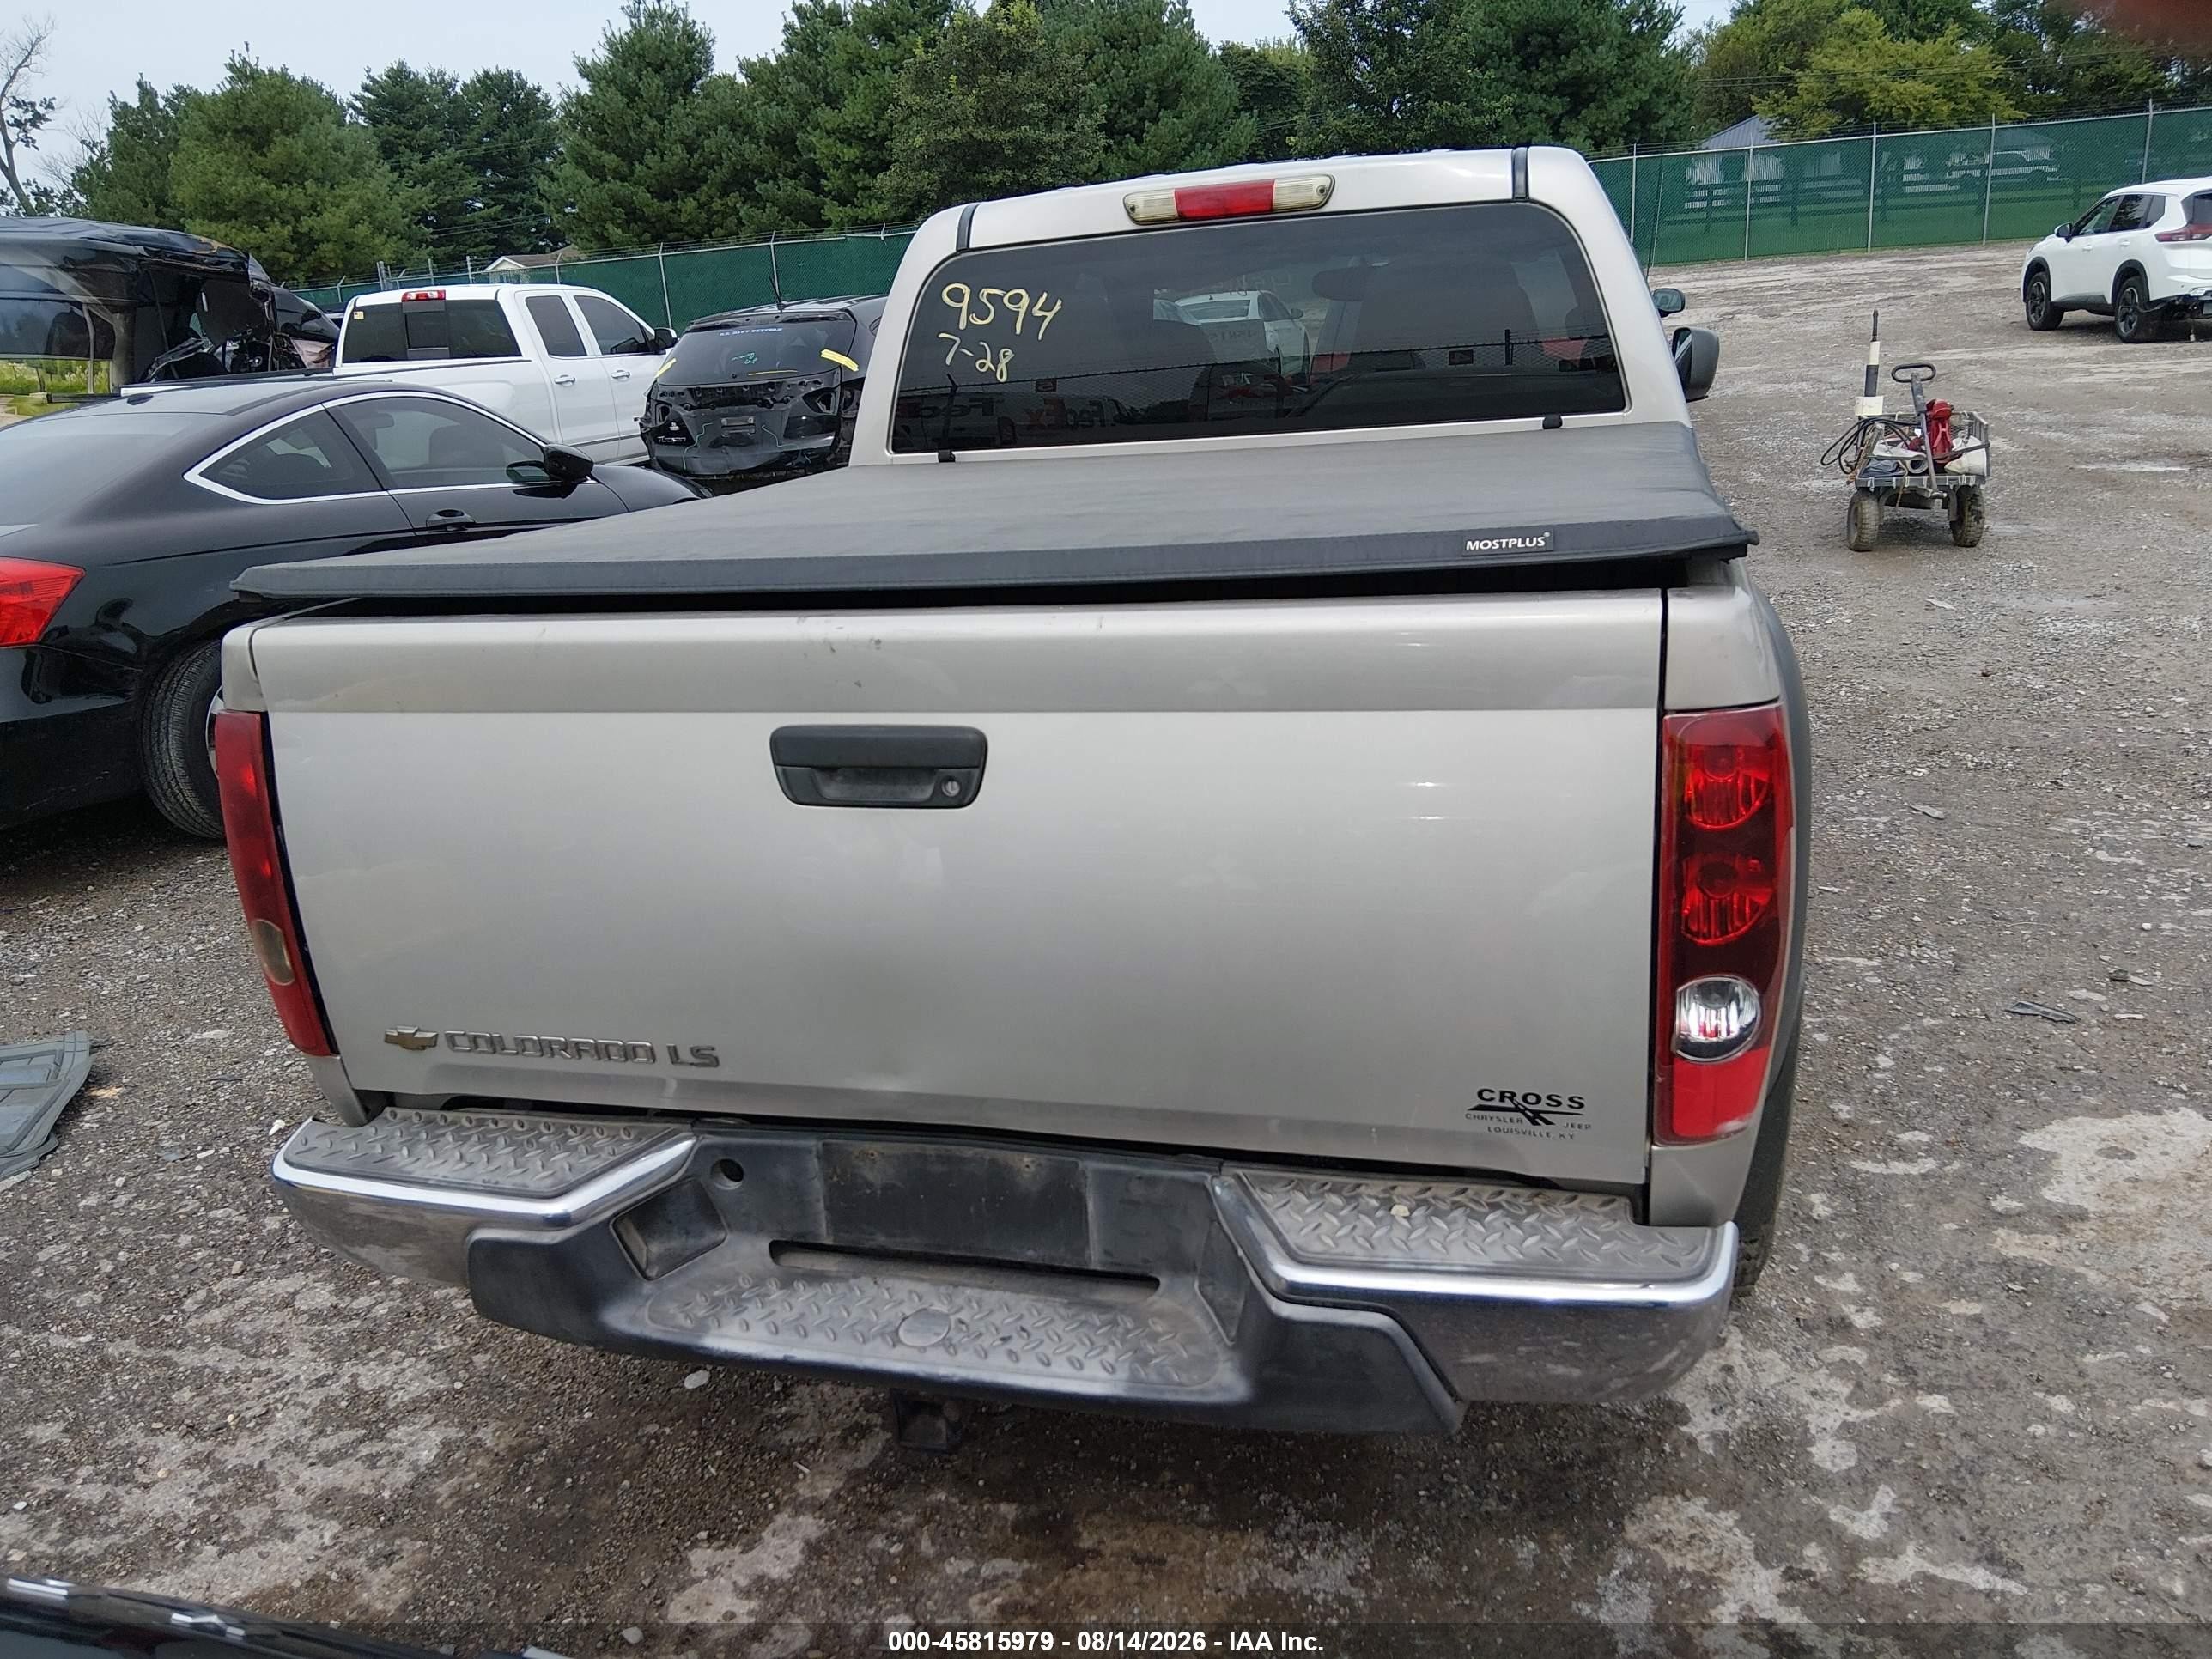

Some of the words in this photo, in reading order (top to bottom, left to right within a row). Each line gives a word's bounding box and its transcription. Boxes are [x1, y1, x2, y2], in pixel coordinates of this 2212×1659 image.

[941, 283, 1062, 340] 9594
[938, 332, 1014, 382] 7-28
[444, 1030, 657, 1065] COLORADO
[665, 1043, 720, 1068] LS
[1476, 1088, 1585, 1109] CROSS
[1464, 1112, 1524, 1125] CHRYSLER
[1563, 1121, 1592, 1131] JEEP
